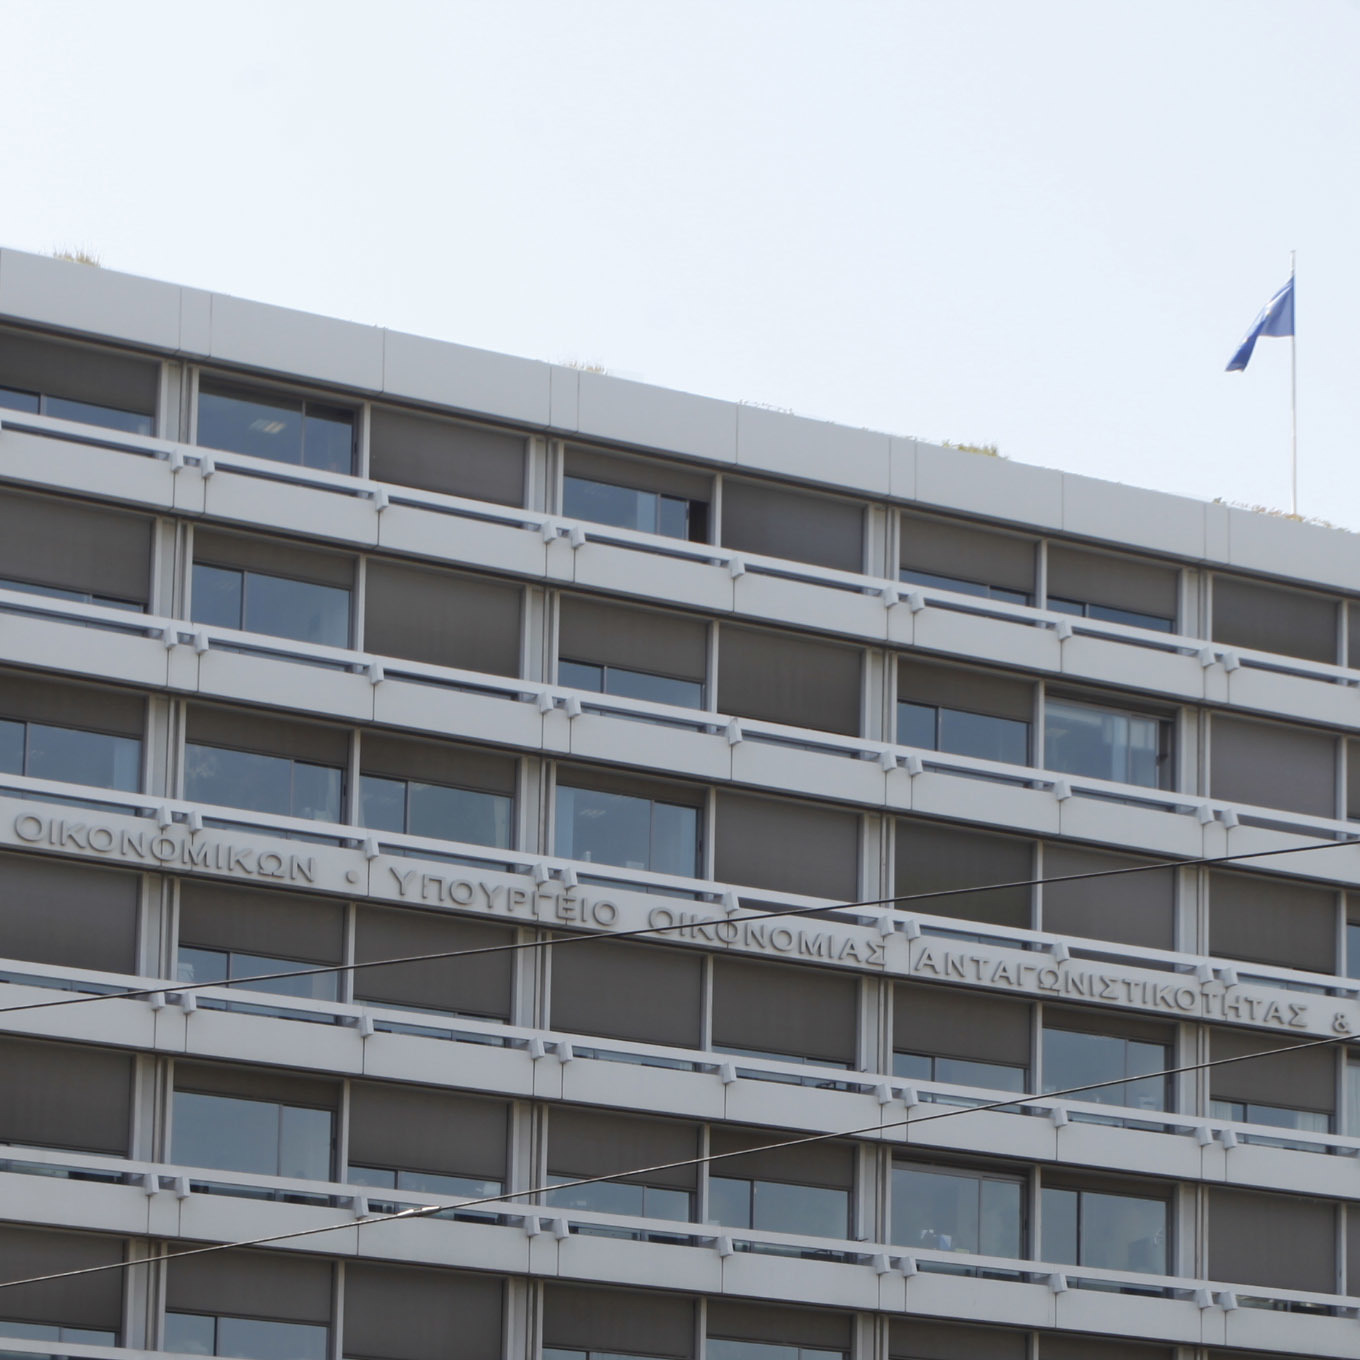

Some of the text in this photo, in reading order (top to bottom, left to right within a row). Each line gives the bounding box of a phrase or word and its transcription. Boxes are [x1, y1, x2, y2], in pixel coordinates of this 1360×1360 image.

[14, 811, 316, 883] ΟΙΚΟΝΟΜΙΚΩΝ
[389, 866, 619, 926] ΥΠΟΥΡΓΕΙΟ
[648, 906, 886, 966] ΟΙΚΟΝΟΜΙΑΣ
[914, 946, 1308, 1029] ΑΝΤΑΓΩΝΙΣΤΙΚΟΤΗΤΑΣ
[1332, 1012, 1352, 1034] &
